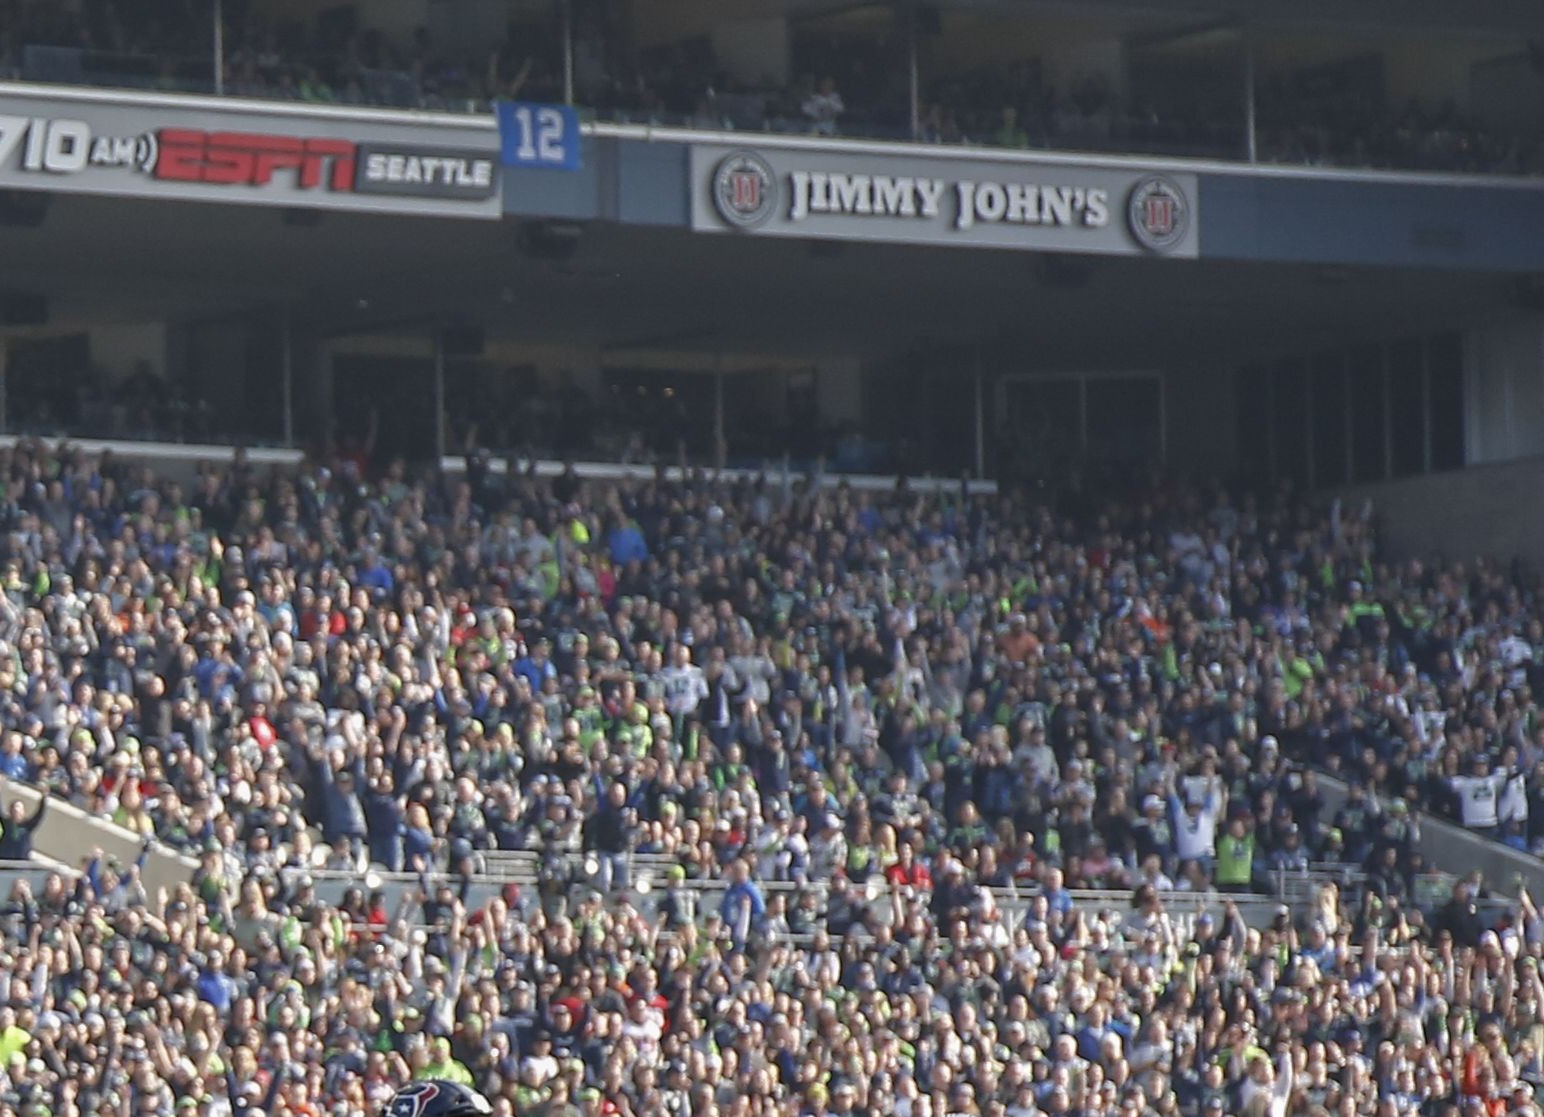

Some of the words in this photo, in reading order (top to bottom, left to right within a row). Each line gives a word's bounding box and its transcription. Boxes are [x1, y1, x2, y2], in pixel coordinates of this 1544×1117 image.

[156, 127, 355, 193] ESPN
[366, 152, 492, 188] SEATTLE
[513, 107, 565, 162] 12
[789, 170, 945, 222] JIMMY
[955, 181, 1110, 231] JOHN'S
